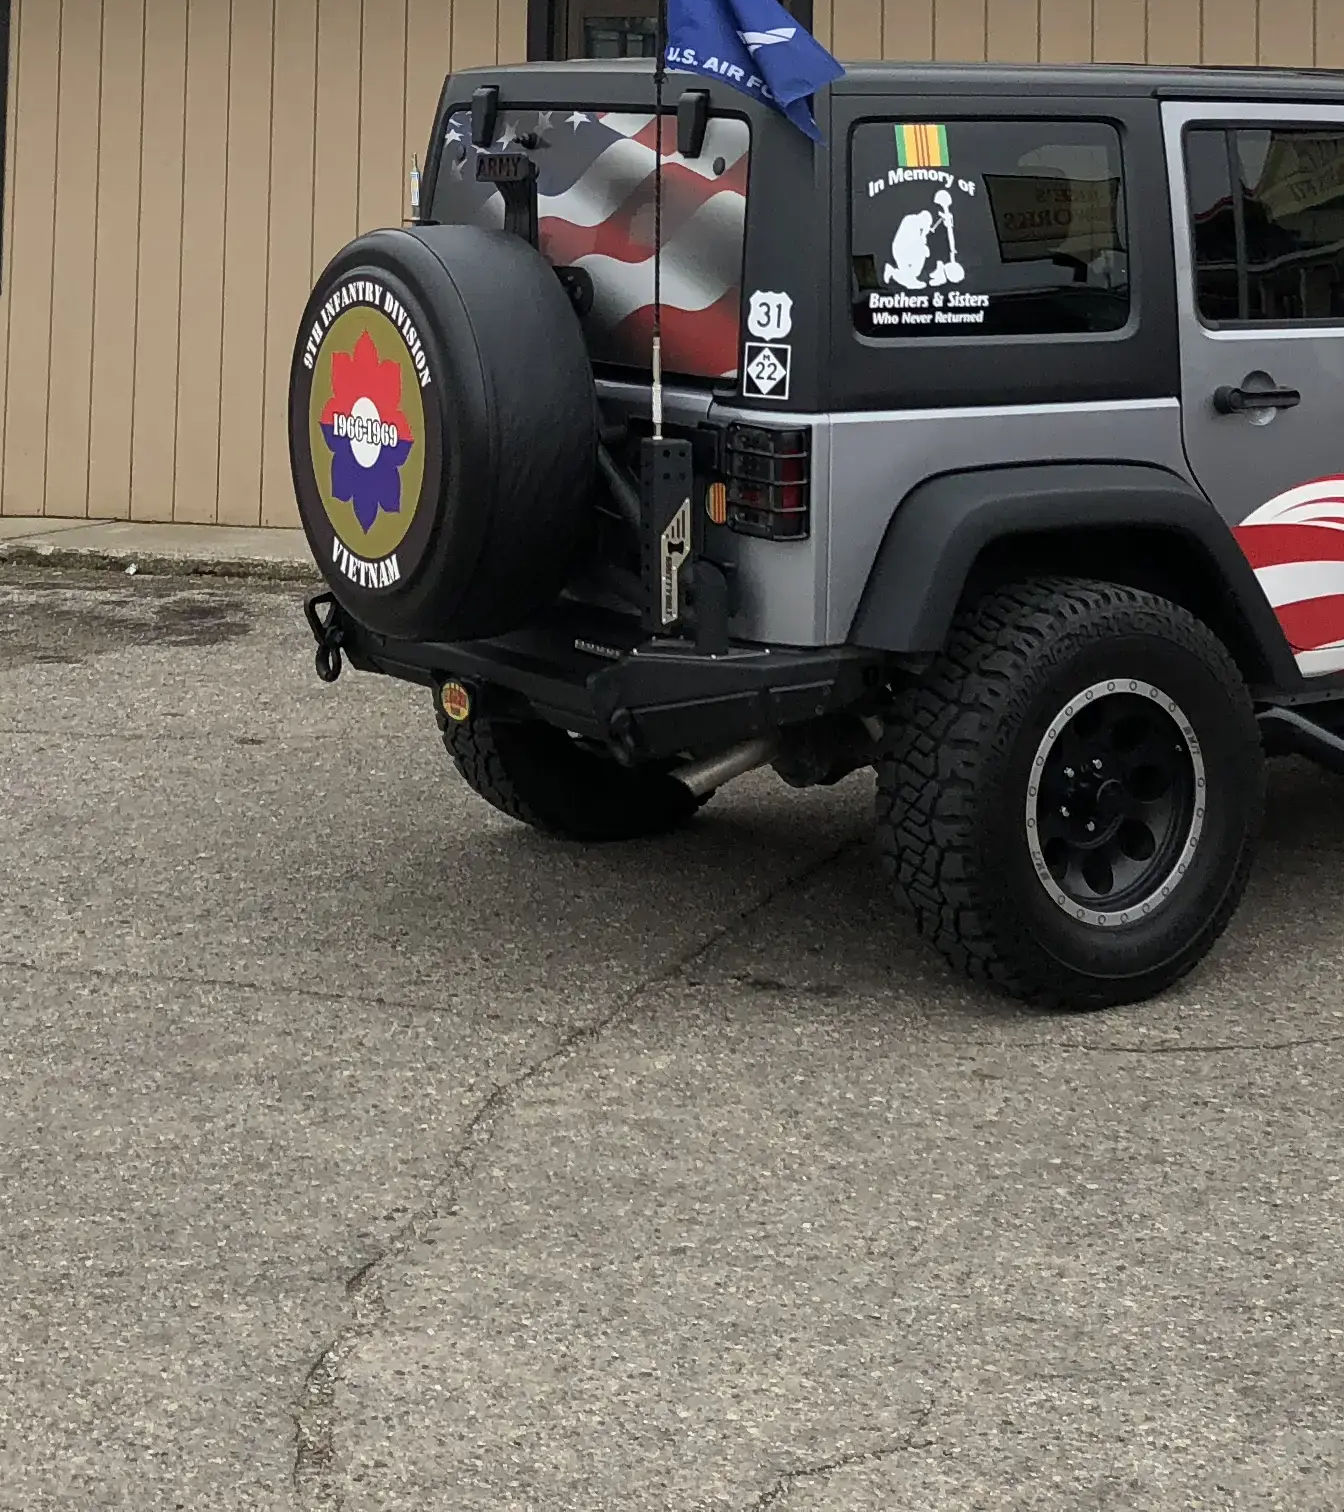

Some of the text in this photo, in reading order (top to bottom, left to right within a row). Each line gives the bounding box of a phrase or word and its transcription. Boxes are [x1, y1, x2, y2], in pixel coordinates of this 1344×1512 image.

[667, 47, 698, 66] U.S.
[703, 56, 745, 81] AIR
[868, 168, 976, 197] In Memory of
[869, 291, 990, 309] Brothers & Sisters
[756, 302, 783, 329] 31
[872, 310, 985, 325] Who Never Returned
[303, 281, 432, 388] 9TH INFANTRY DIVISION
[754, 361, 778, 381] 22
[762, 353, 771, 362] M
[332, 412, 399, 449] 1966-1969
[332, 535, 401, 589] VIETNAM
